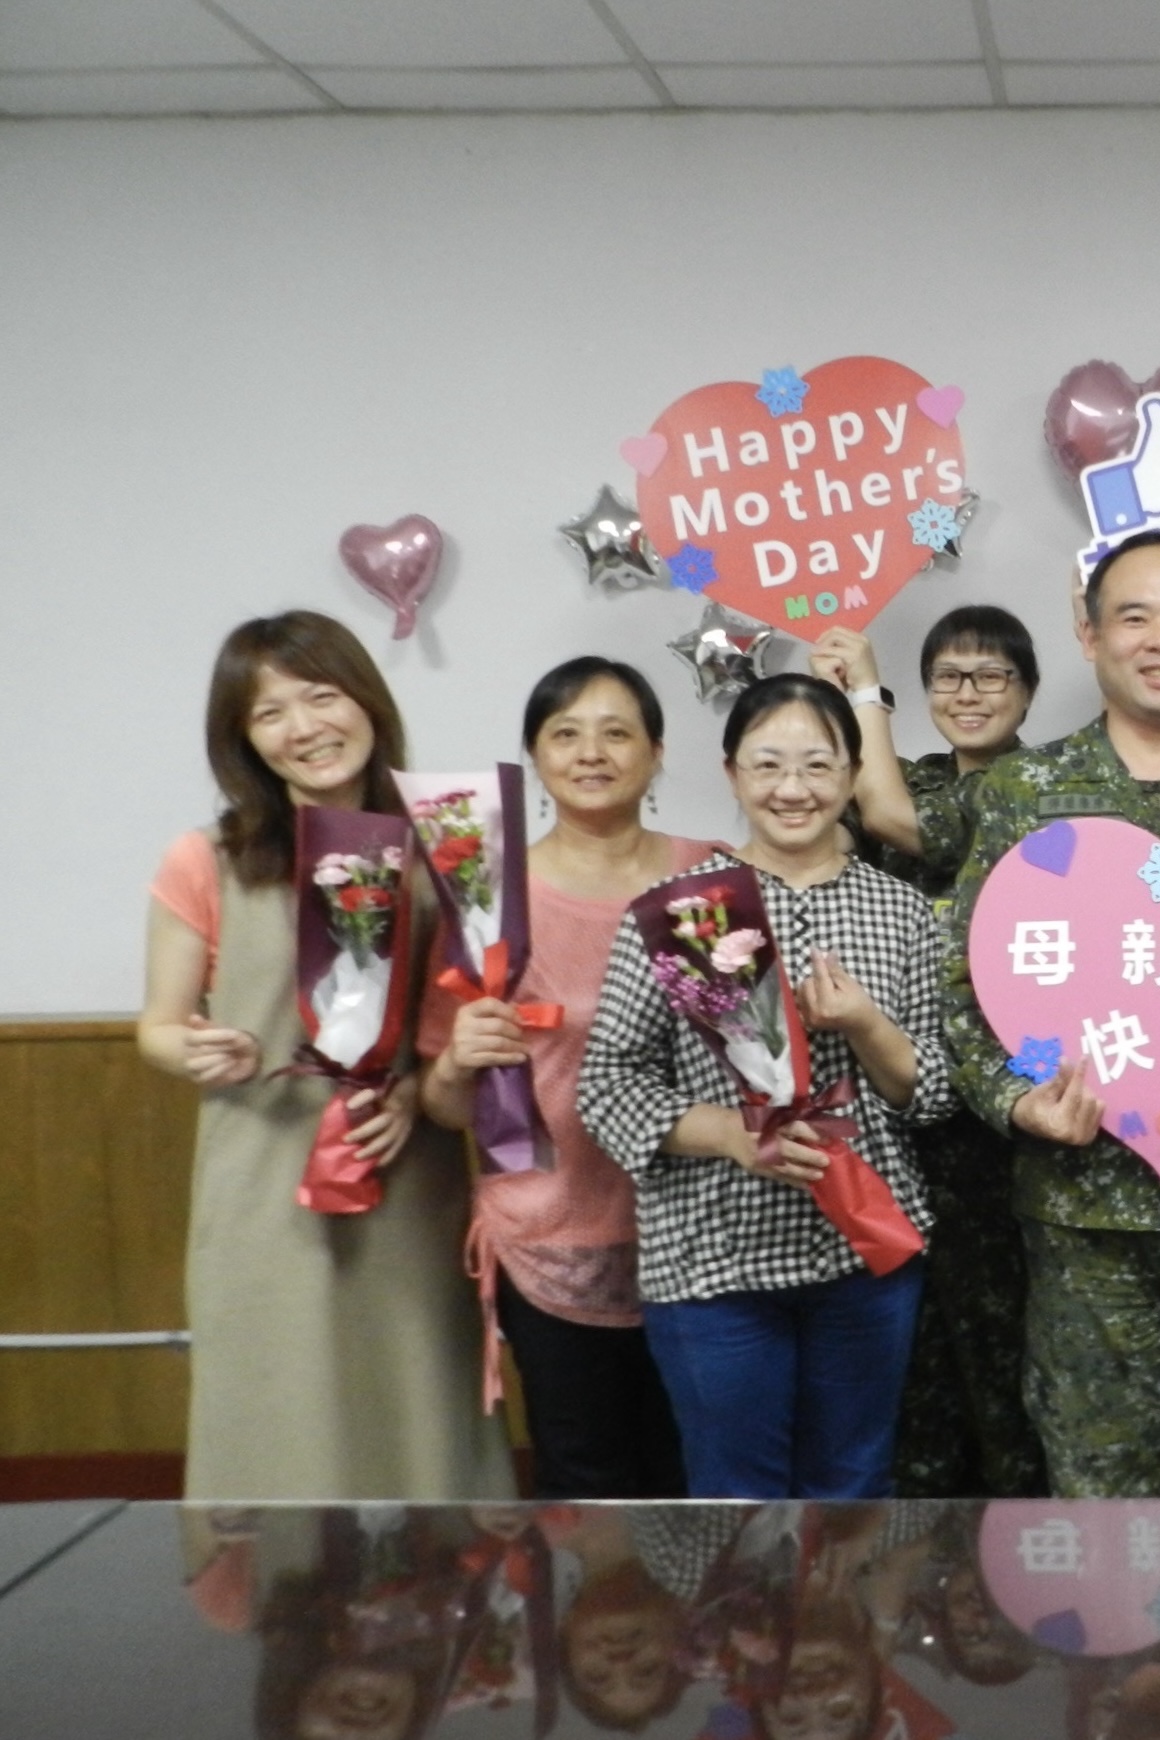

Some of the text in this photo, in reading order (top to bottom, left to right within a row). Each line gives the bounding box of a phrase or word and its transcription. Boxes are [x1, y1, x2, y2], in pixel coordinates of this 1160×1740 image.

[684, 403, 908, 478] Happy
[668, 448, 963, 541] Mother's
[753, 529, 885, 588] Day
[784, 584, 868, 620] MOM
